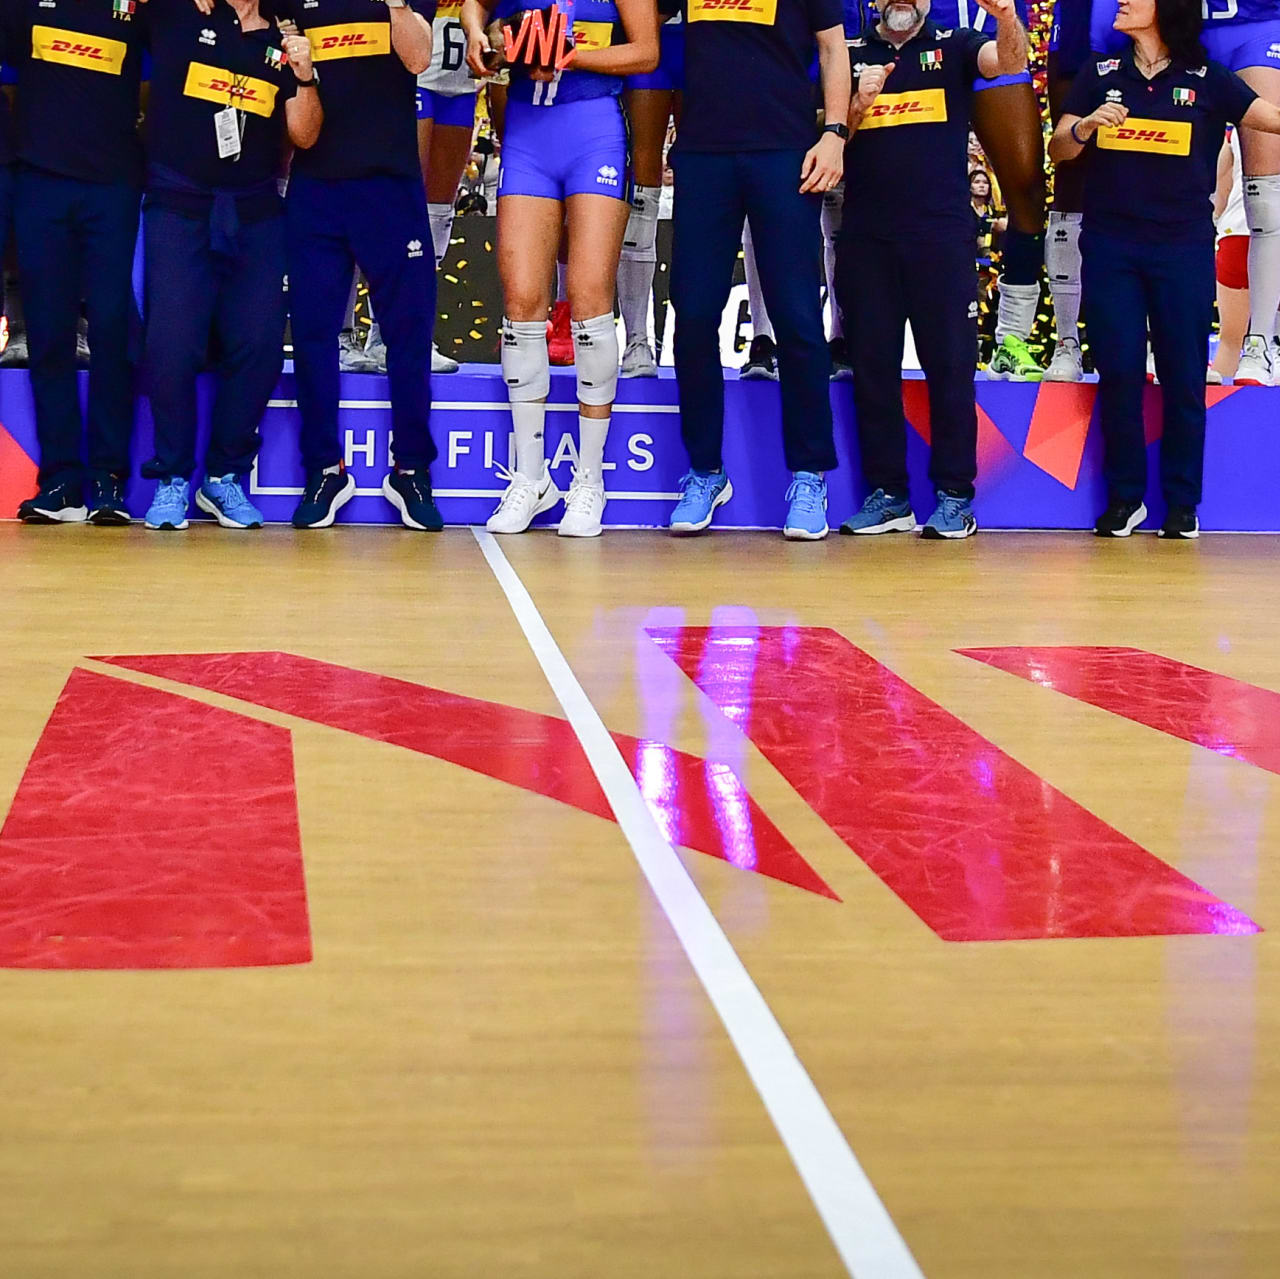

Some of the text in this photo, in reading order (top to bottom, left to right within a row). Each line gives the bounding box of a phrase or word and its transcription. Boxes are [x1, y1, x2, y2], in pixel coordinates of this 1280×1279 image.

[113, 10, 132, 21] ITA
[322, 33, 368, 49] DHL
[503, 3, 578, 70] VNL
[51, 39, 104, 60] DHL
[442, 22, 465, 71] 6
[921, 60, 942, 72] ITA
[871, 101, 924, 118] DHL
[1173, 98, 1193, 107] ITA
[1116, 128, 1169, 143] DHL
[448, 430, 656, 472] FIAS
